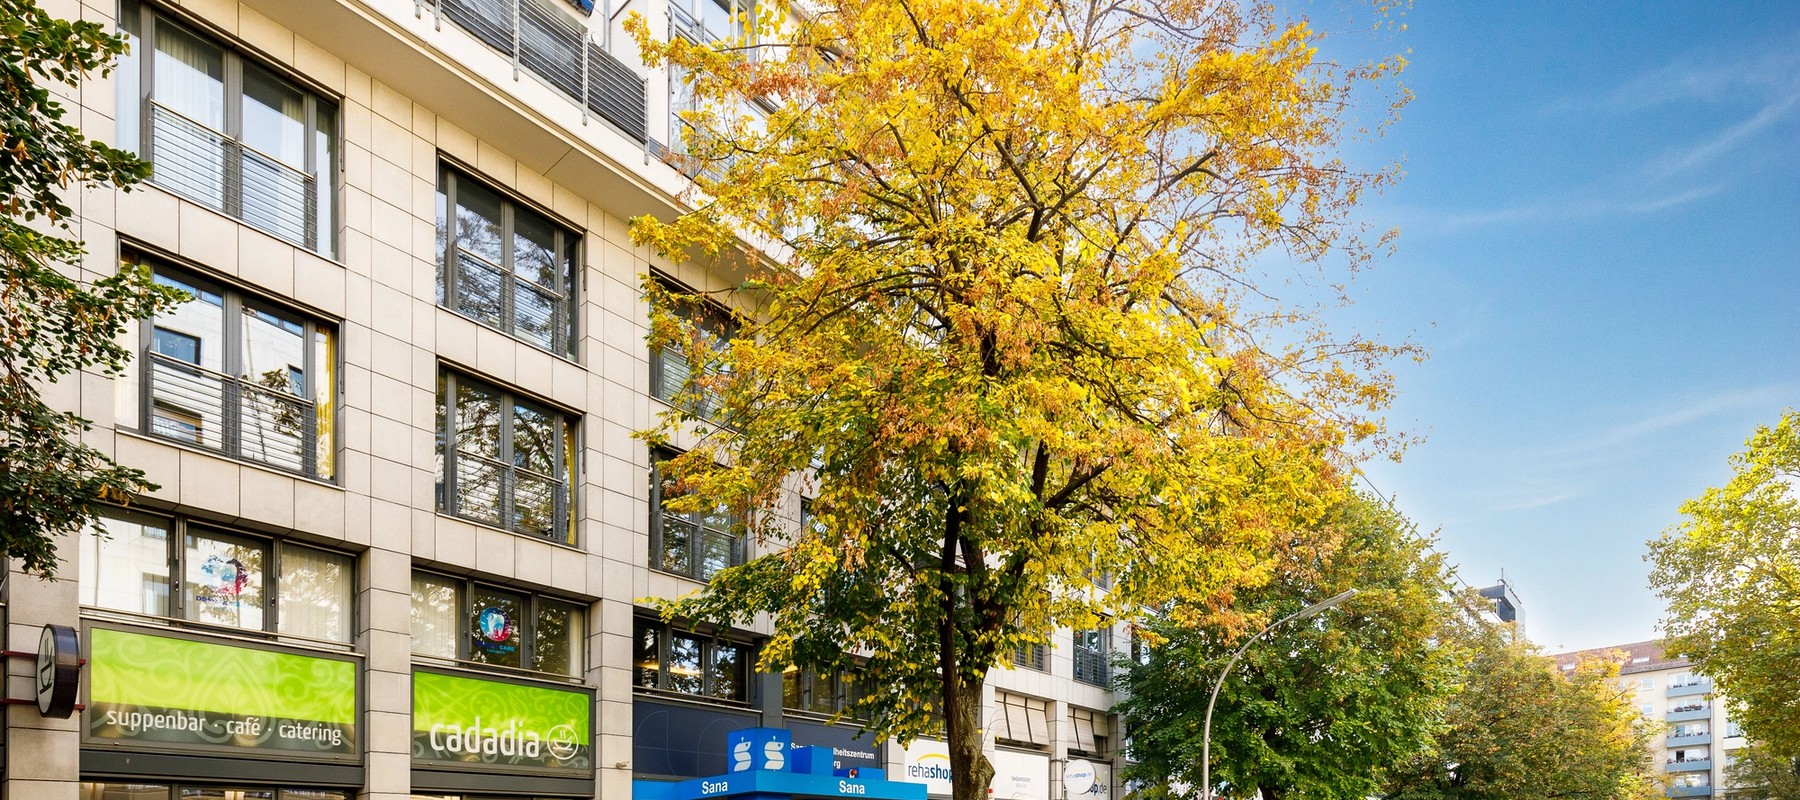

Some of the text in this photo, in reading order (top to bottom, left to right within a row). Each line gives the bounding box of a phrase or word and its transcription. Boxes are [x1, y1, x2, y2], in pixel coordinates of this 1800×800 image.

[106, 710, 342, 746] suppenbar café catering
[429, 716, 540, 758] cadadia
[702, 781, 728, 795] Sana
[839, 780, 865, 795] Sana
